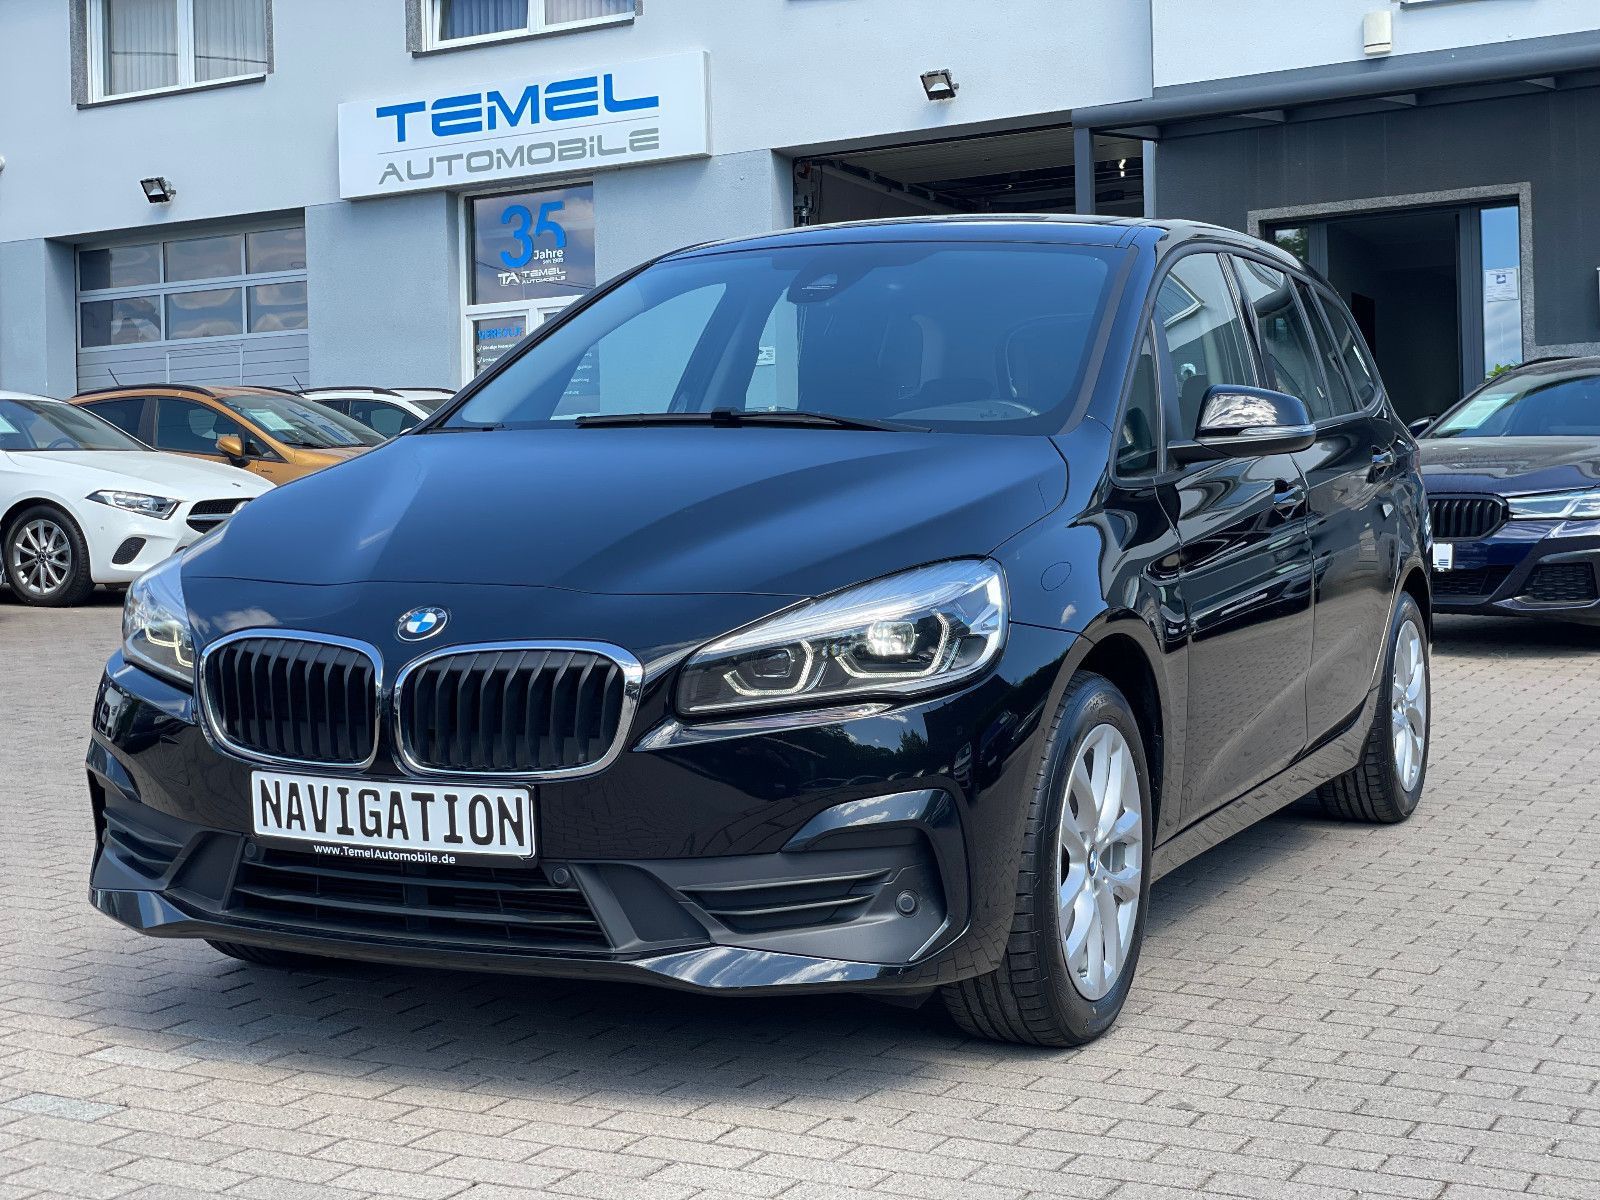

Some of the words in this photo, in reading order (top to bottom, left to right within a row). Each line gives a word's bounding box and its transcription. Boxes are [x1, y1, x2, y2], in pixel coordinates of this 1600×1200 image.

[376, 73, 659, 142] TEMEL
[500, 200, 567, 268] 35
[534, 249, 564, 260] Jahre
[498, 272, 520, 286] TA
[521, 267, 566, 278] TEMEL
[260, 779, 525, 846] NAVIGATION
[313, 843, 456, 864] www.TemelAutomobile.de
